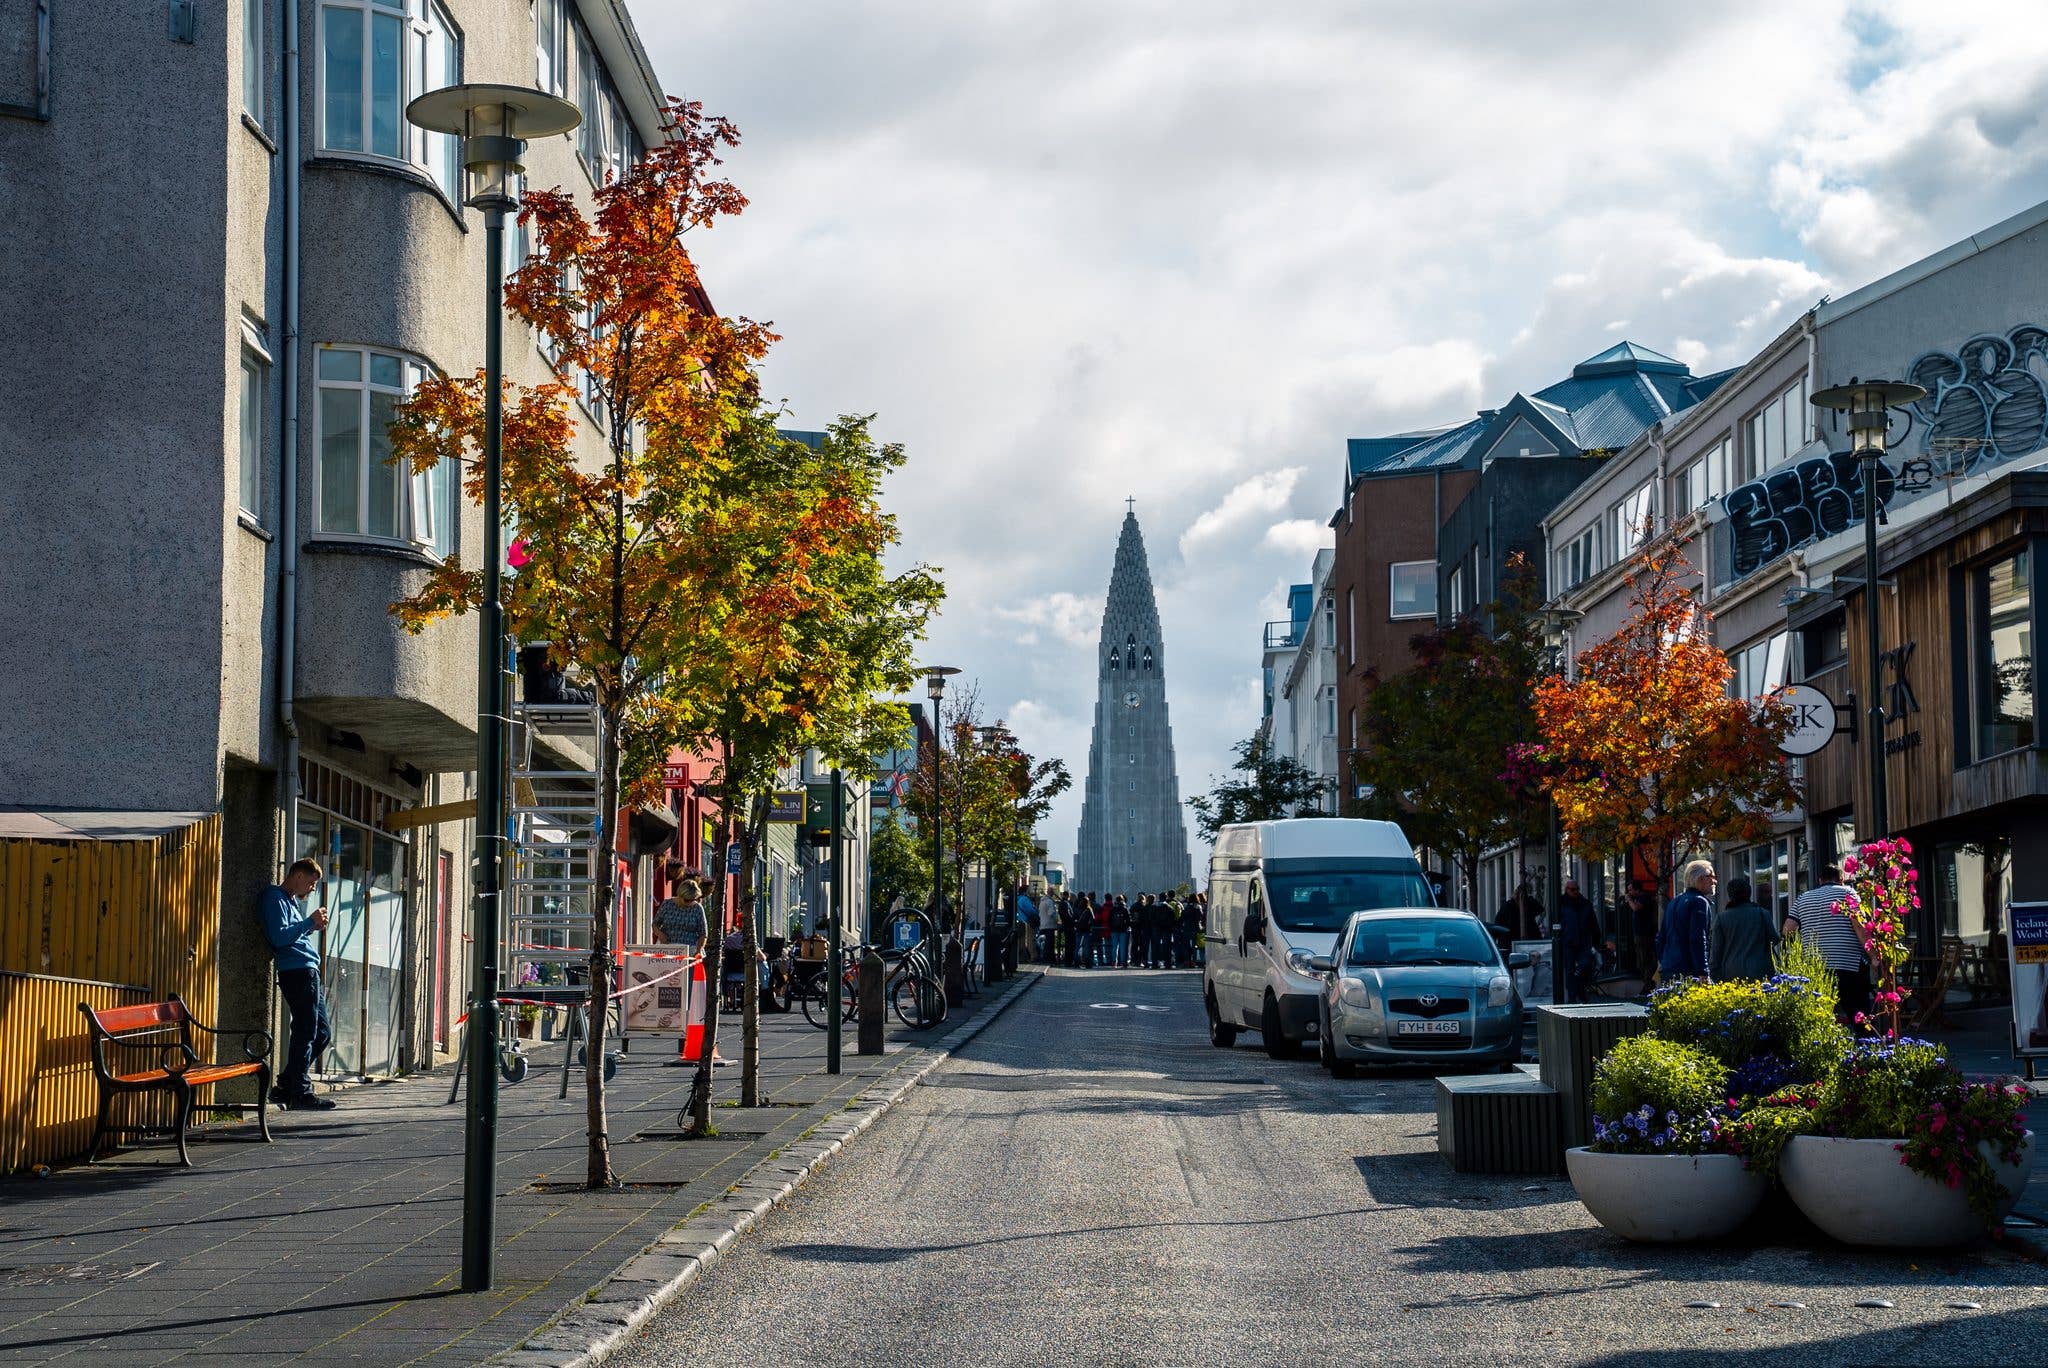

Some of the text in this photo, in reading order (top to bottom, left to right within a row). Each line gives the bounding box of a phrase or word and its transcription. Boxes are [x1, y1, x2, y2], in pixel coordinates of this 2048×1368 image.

[2016, 929, 2042, 939] Wool
[642, 947, 683, 956] Handmade
[1408, 1022, 1458, 1032] YH 465
